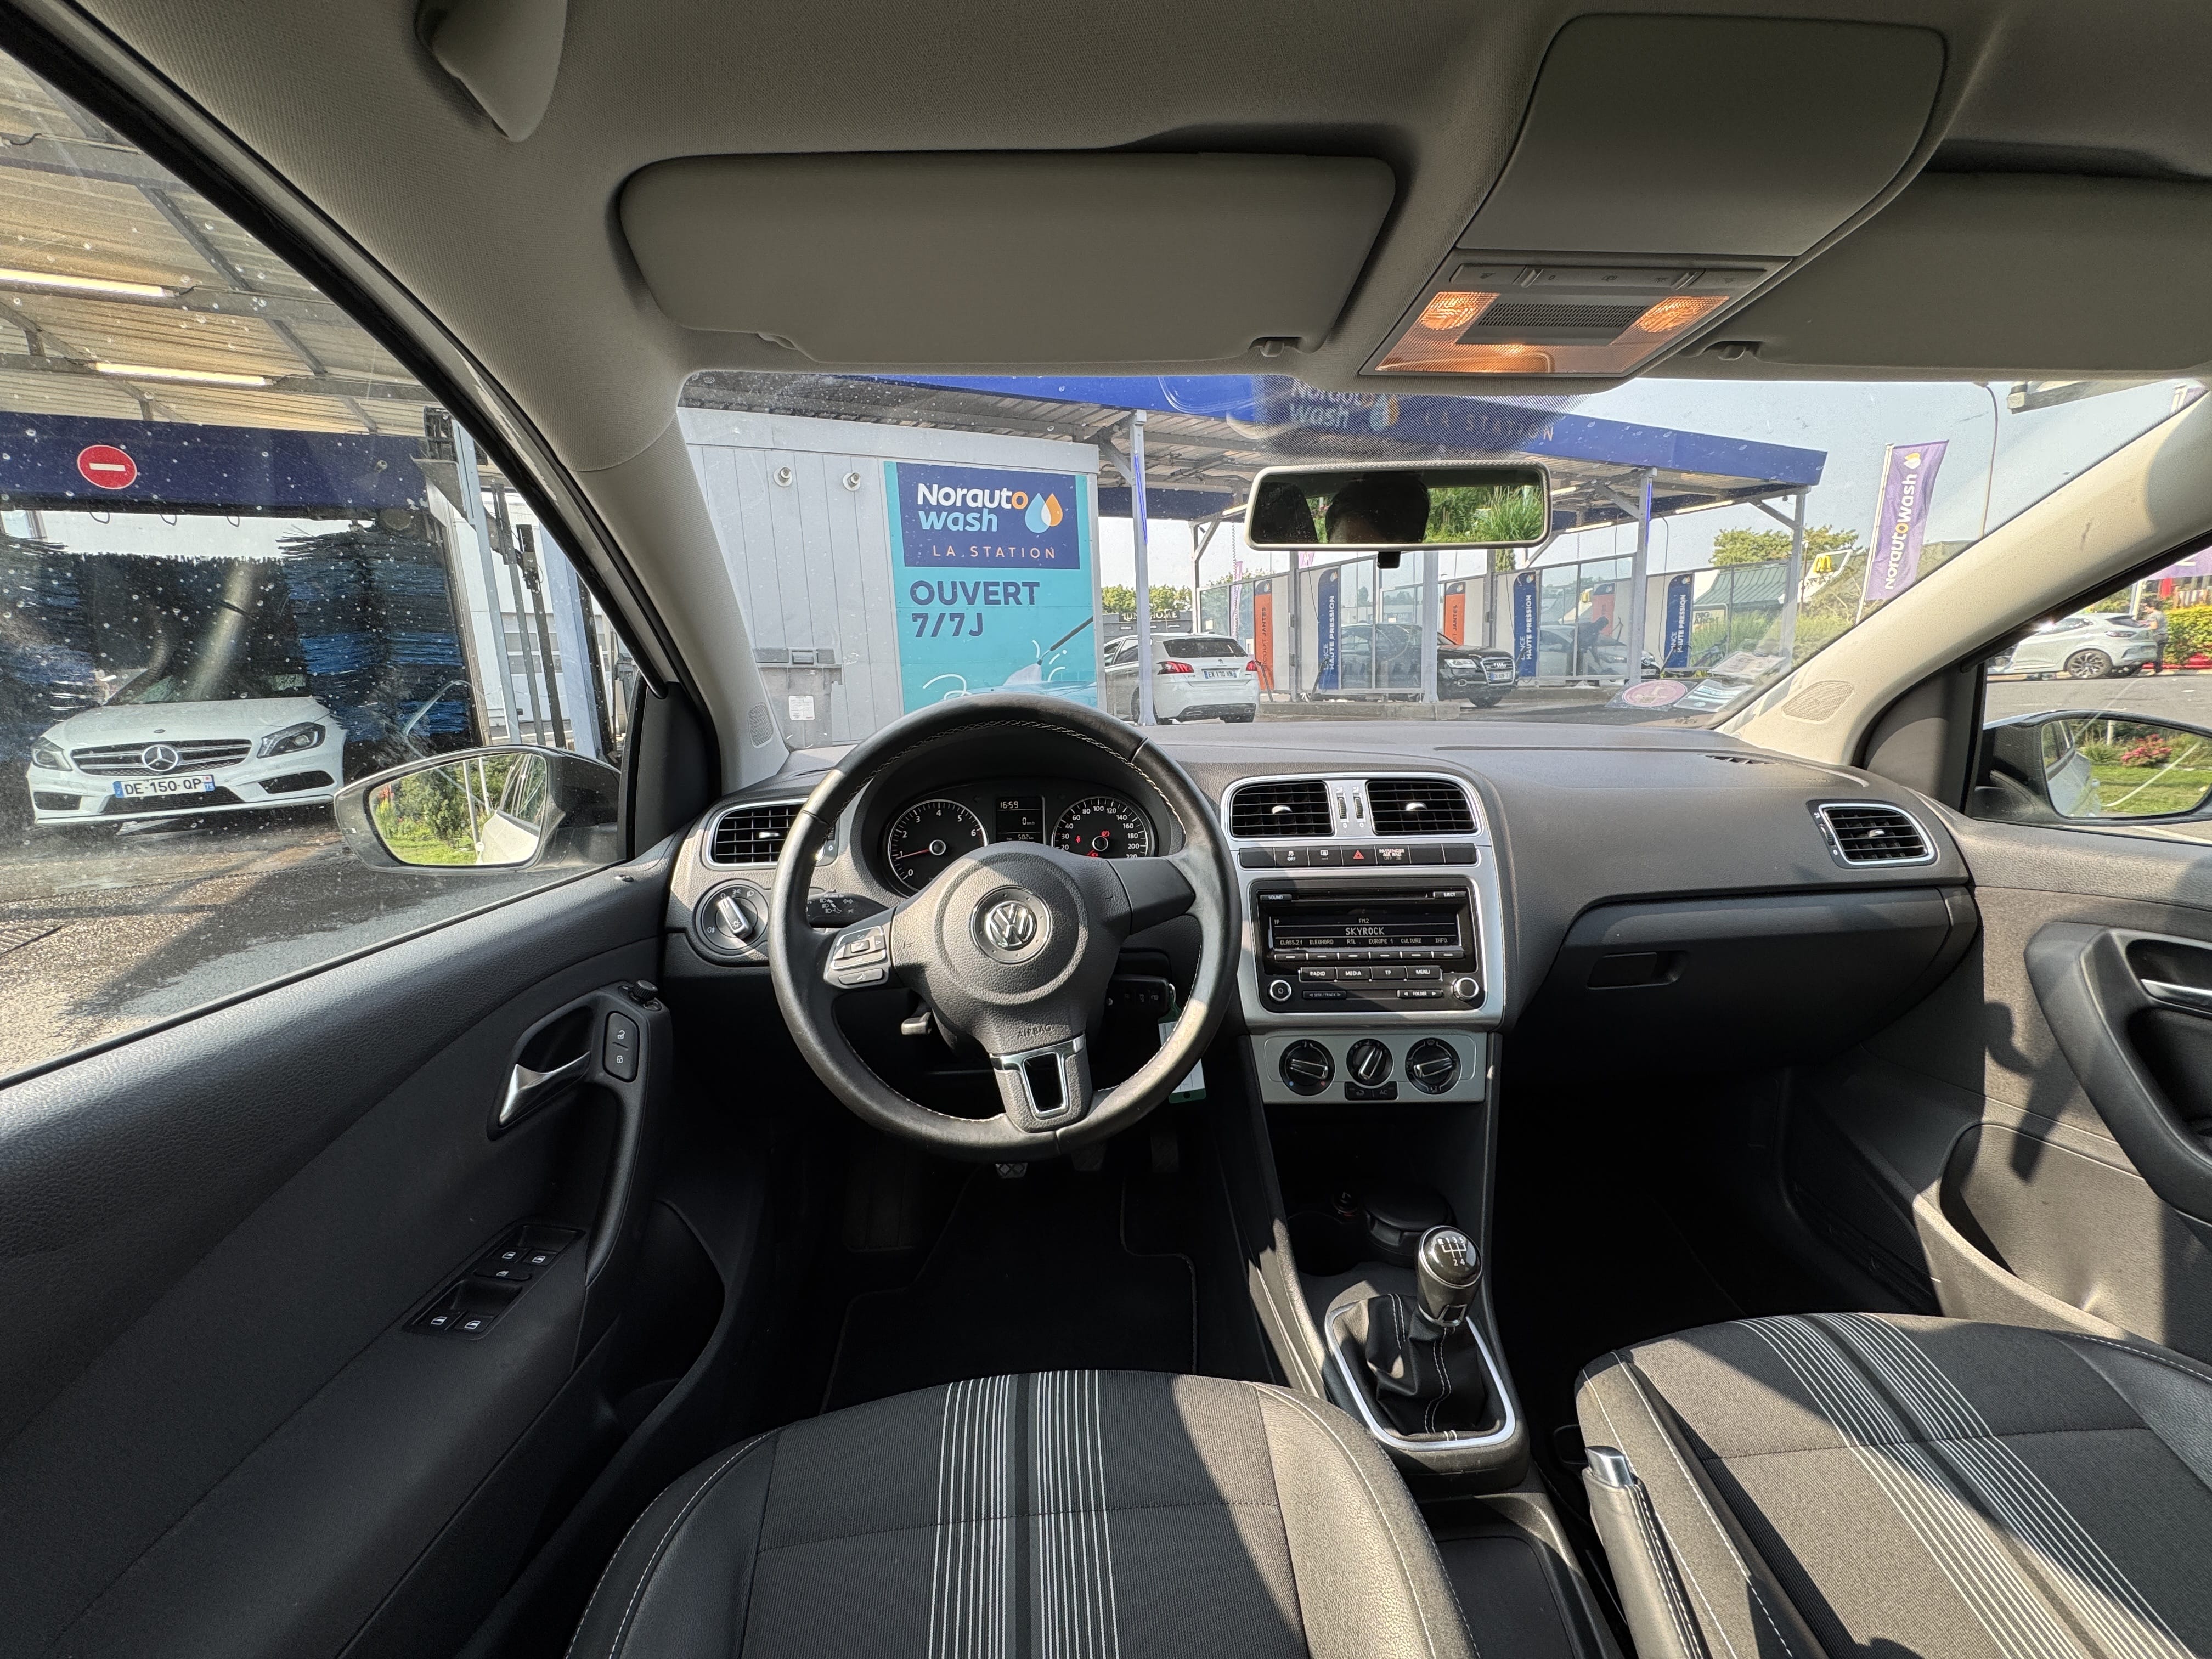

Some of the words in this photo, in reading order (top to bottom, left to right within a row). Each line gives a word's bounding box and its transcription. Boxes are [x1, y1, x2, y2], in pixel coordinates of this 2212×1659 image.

[917, 483, 1029, 510] Norauto
[918, 508, 998, 532] wash
[933, 545, 956, 557] LA
[969, 546, 1055, 558] STATION
[910, 580, 1040, 606] OUVERT
[912, 612, 984, 637] 7/7J
[1000, 800, 1019, 809] 16:59
[1022, 817, 1027, 825] 0
[1345, 927, 1385, 935] SKYROCK
